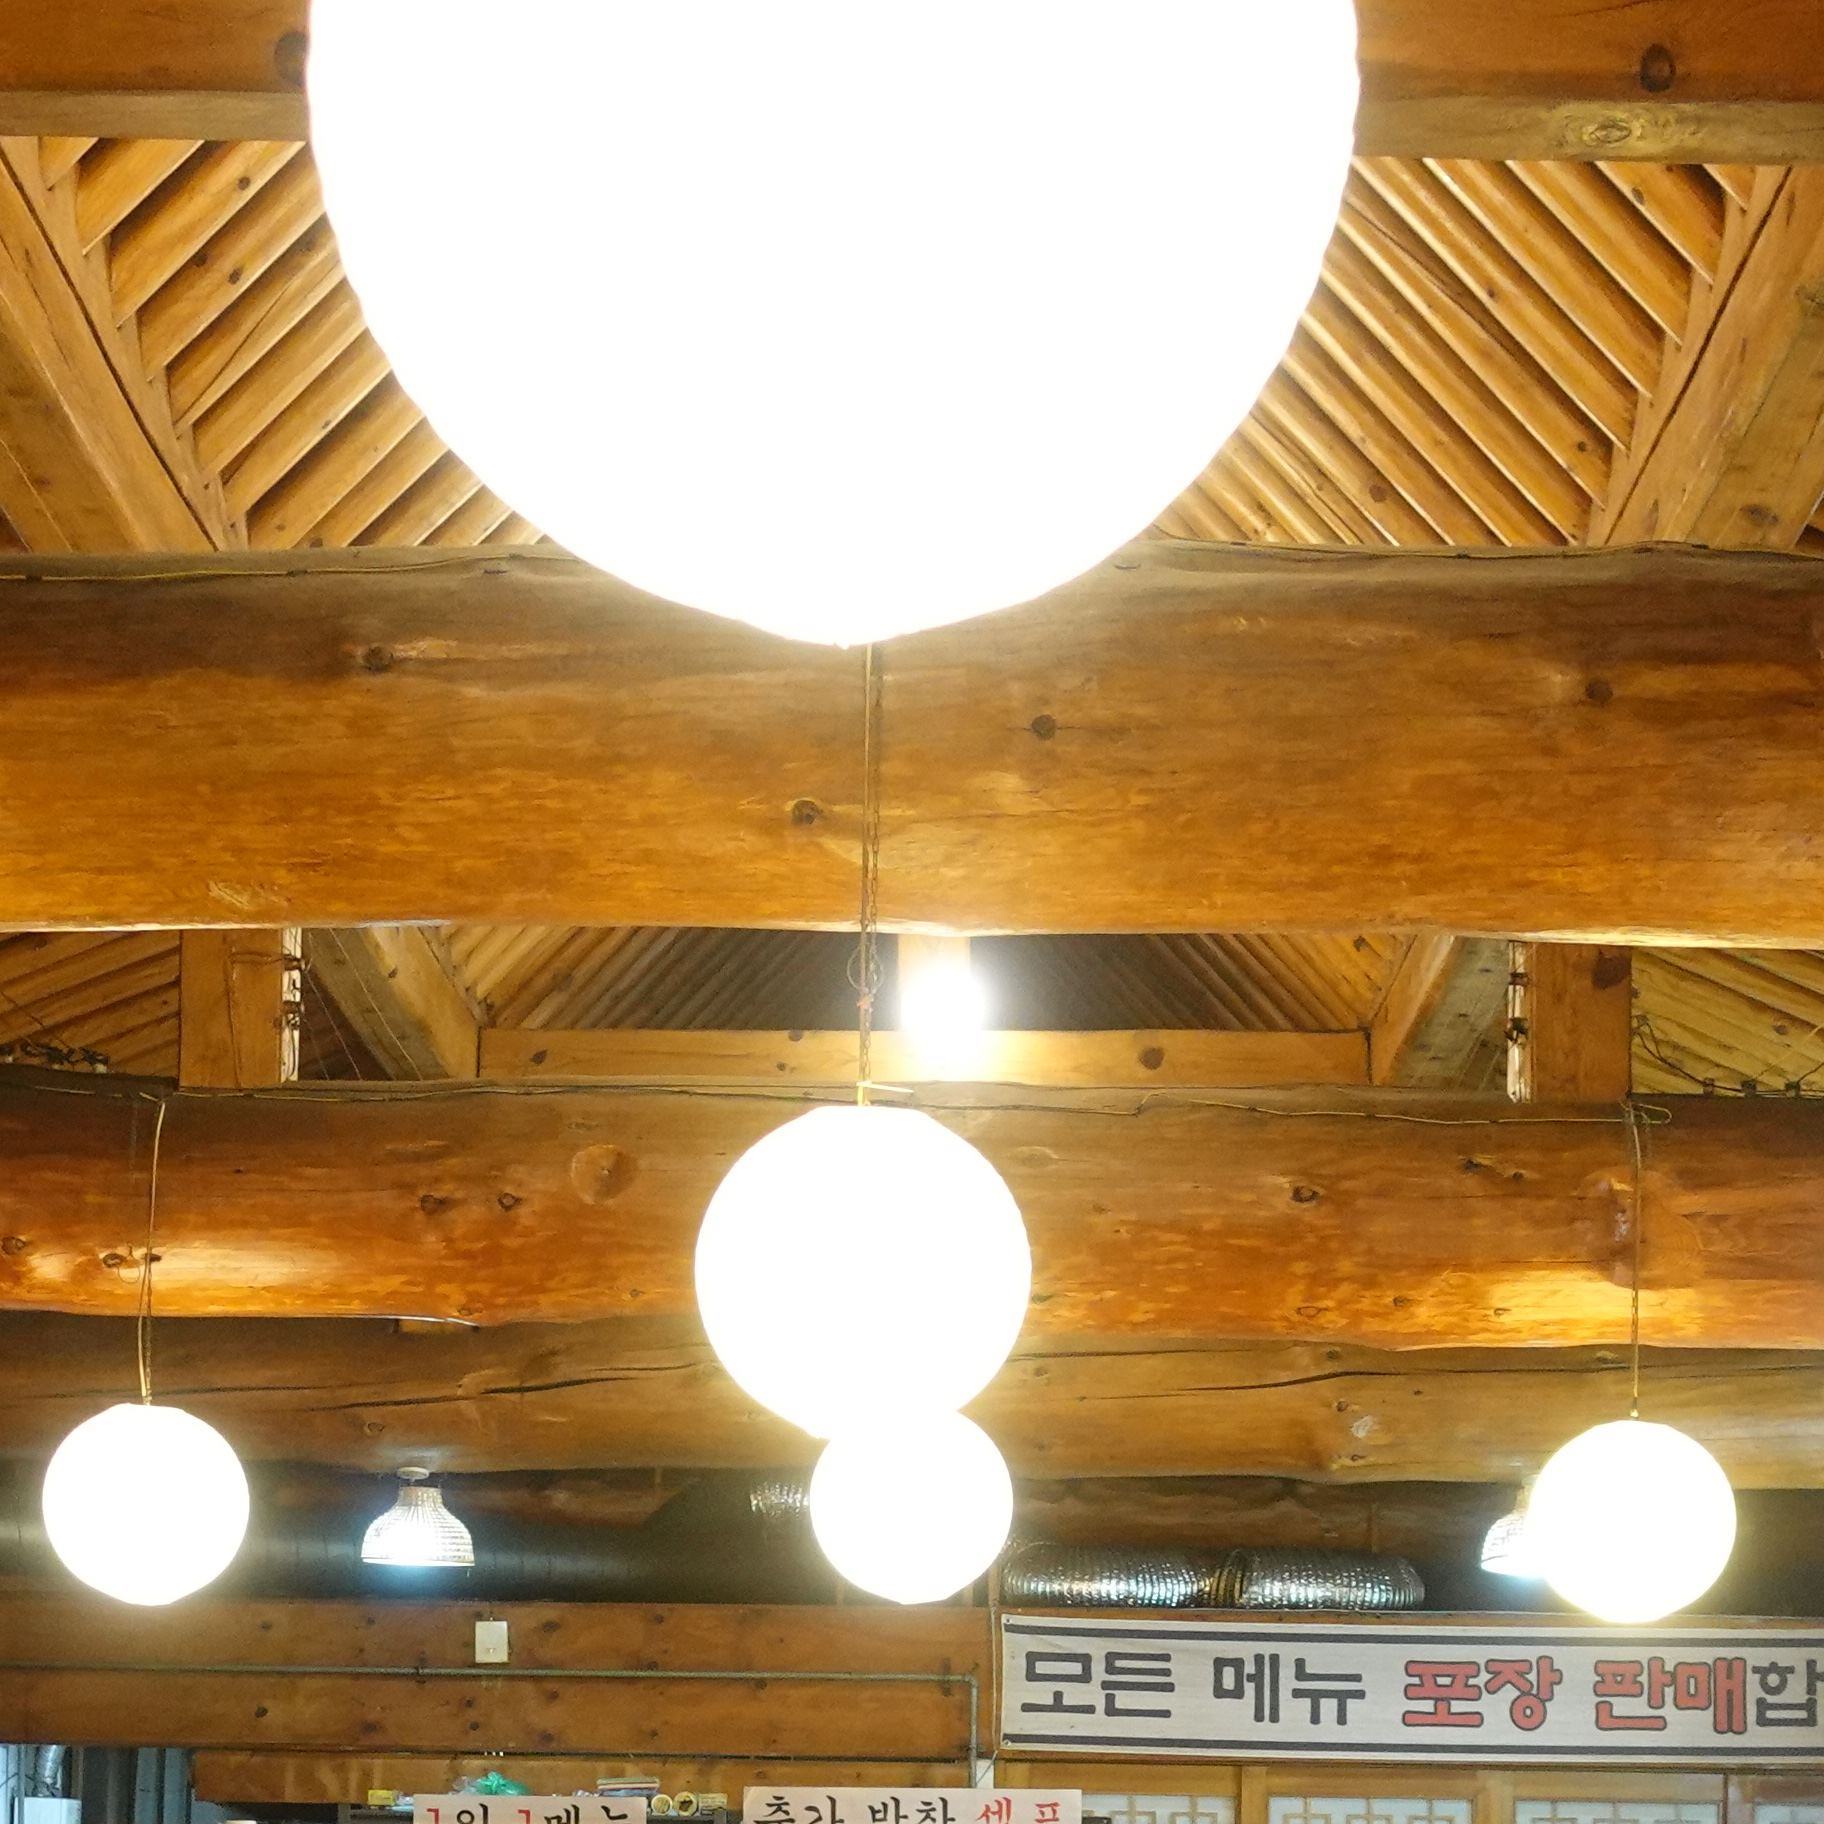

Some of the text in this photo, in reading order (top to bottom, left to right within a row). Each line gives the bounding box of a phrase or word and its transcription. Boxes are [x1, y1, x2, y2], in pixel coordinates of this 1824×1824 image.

[1021, 1651, 1175, 1718] 모든
[1213, 1653, 1366, 1726] 메뉴
[1402, 1655, 1563, 1731] 포장
